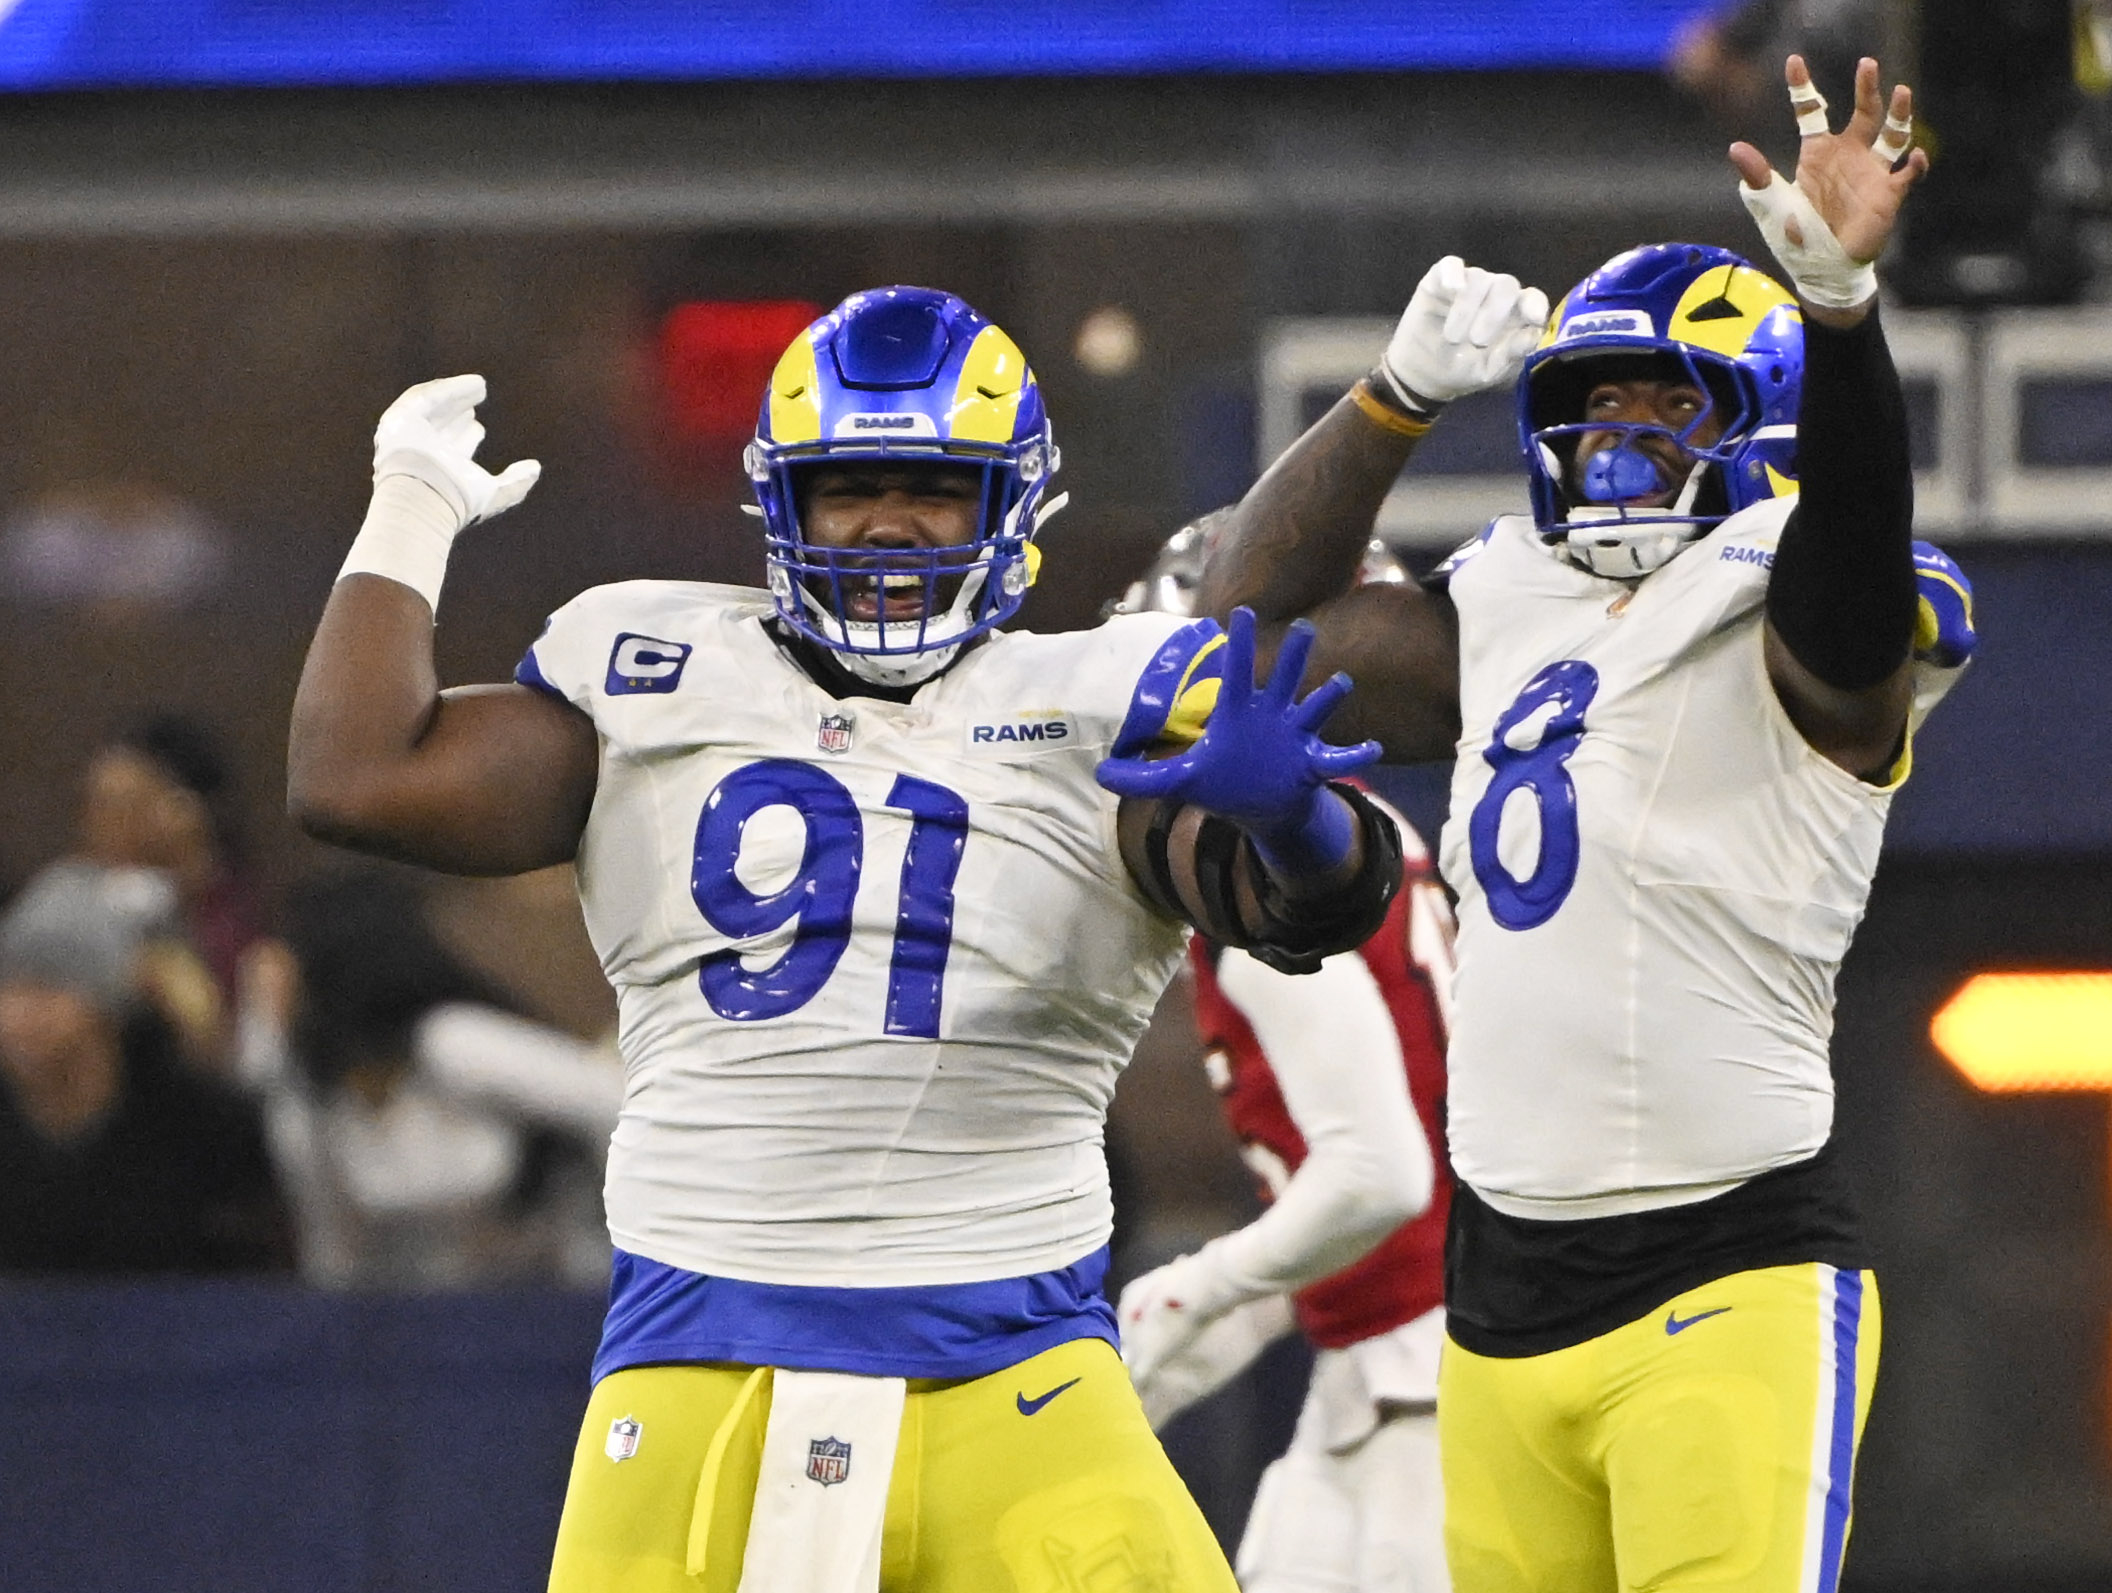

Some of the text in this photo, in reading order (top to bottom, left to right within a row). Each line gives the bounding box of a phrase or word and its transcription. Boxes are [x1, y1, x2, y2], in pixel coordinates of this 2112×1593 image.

[1567, 318, 1637, 337] RAMS
[854, 416, 914, 429] RAMS
[1719, 545, 1777, 571] RAMS
[821, 729, 847, 749] NFL
[972, 721, 1068, 744] RAMS
[1469, 659, 1598, 931] 8
[691, 758, 968, 1038] 91
[811, 1457, 845, 1481] NFL
